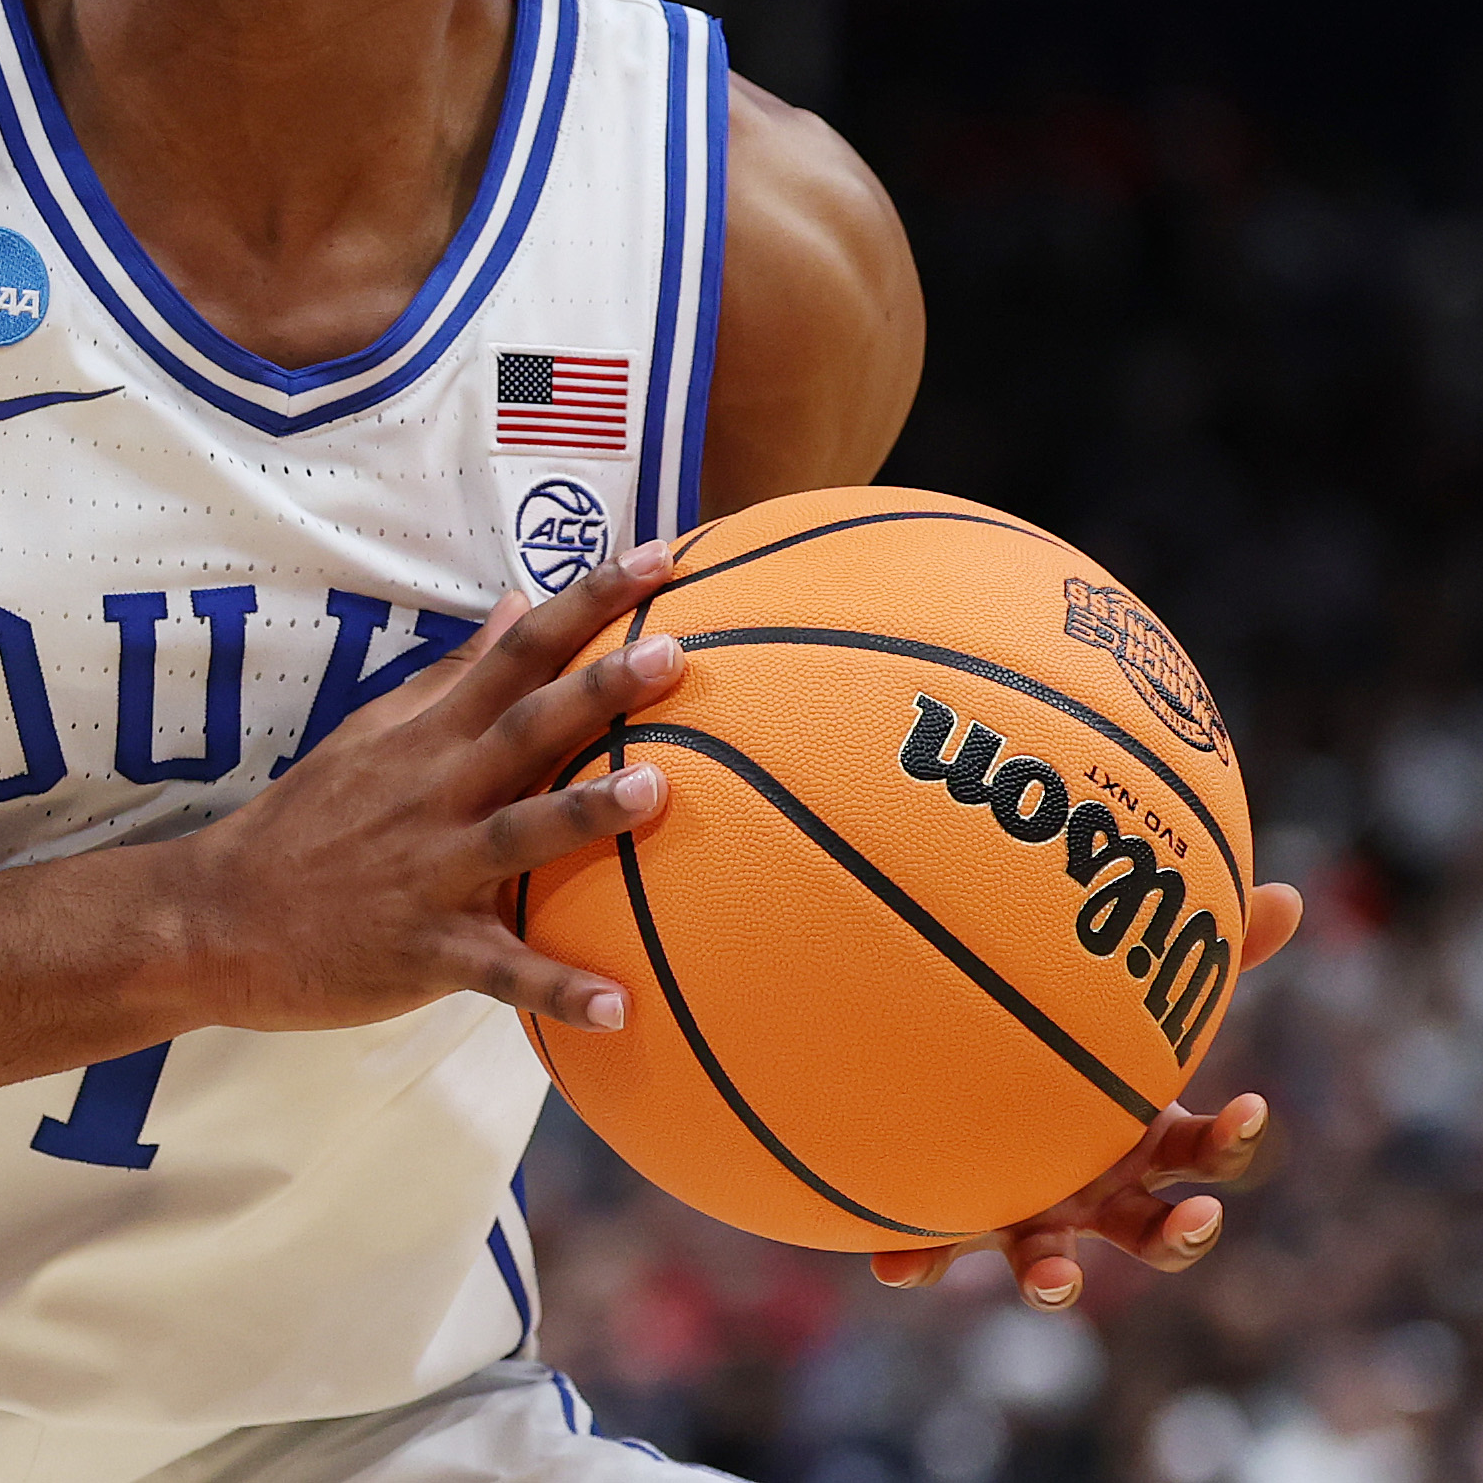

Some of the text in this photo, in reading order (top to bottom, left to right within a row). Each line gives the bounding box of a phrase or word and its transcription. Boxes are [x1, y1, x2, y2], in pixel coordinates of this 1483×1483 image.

[527, 517, 605, 546] ACC
[1083, 764, 1188, 859] EVO NXT
[898, 692, 1232, 1068] Wilson
